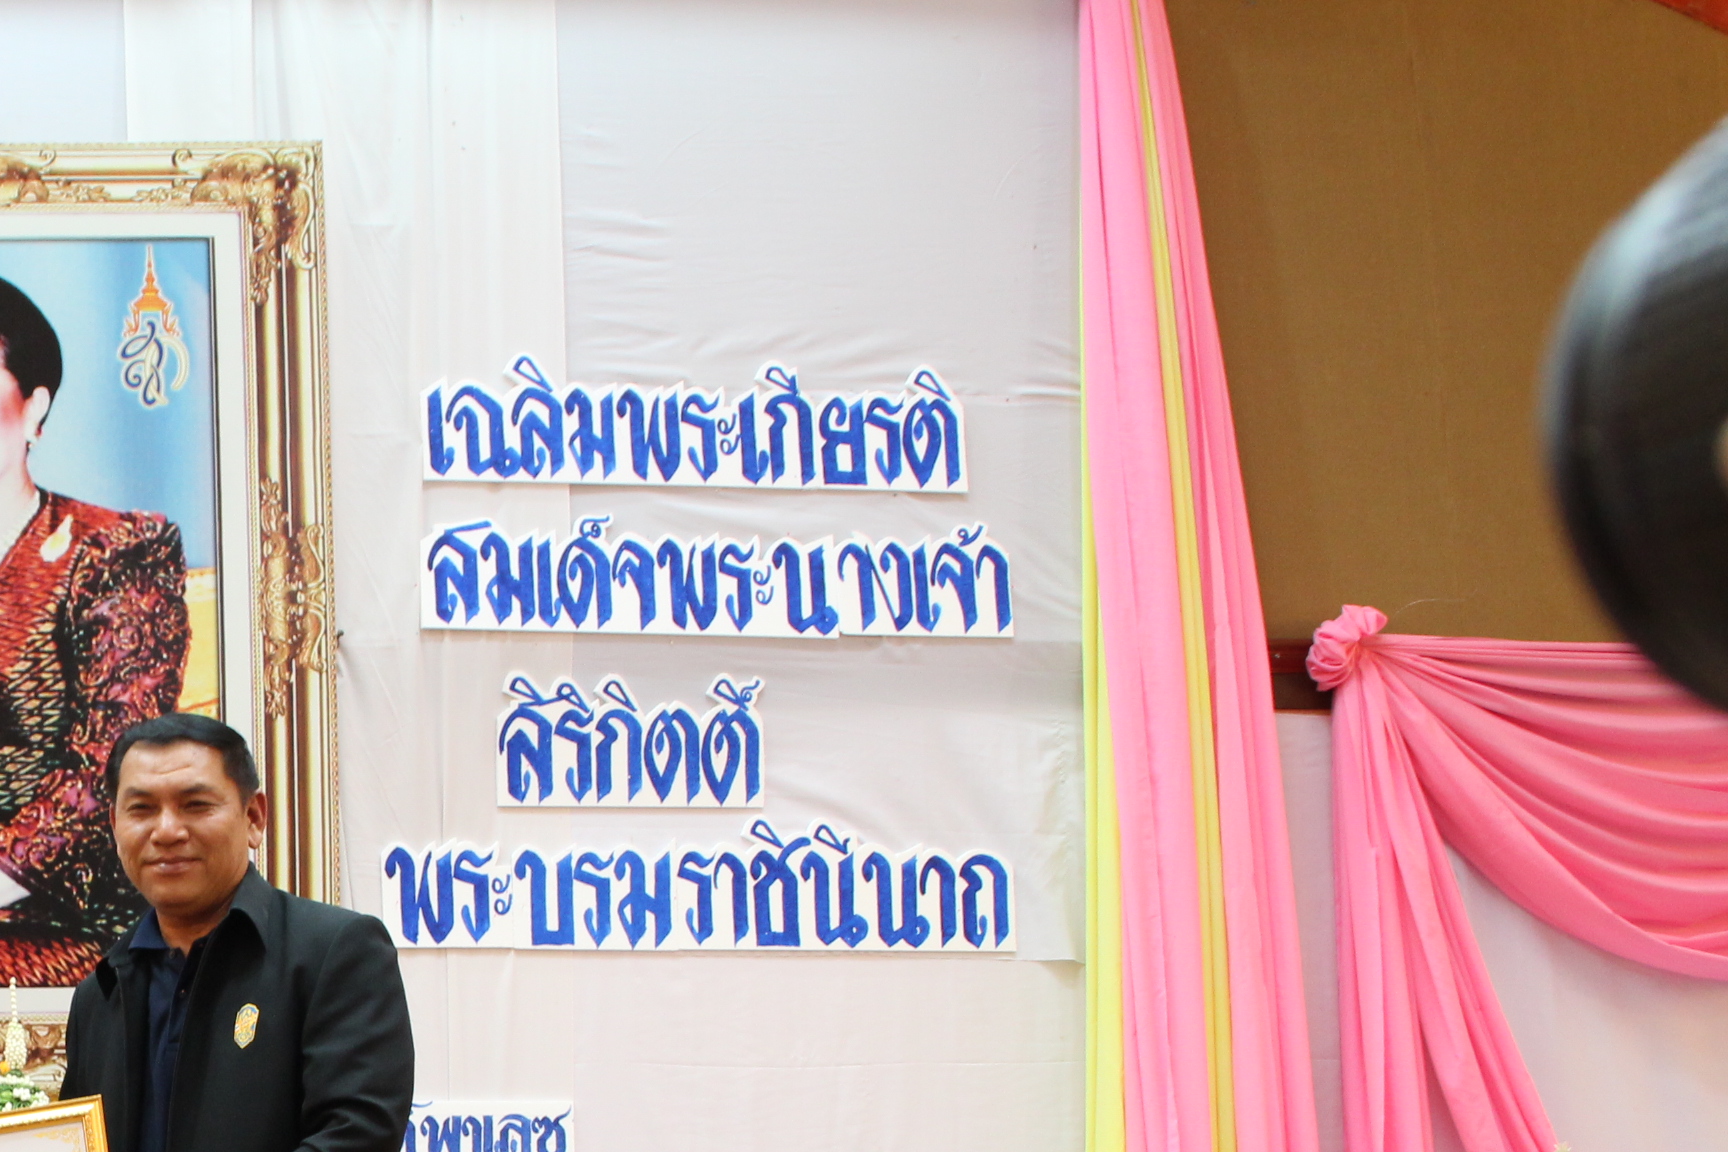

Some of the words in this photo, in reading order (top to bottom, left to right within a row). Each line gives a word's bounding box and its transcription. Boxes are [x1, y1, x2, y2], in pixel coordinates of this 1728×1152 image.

[427, 356, 961, 488] เฉลิมพระเกียรติ
[428, 515, 1013, 635] สมเด็จพระนางเจ้า
[385, 819, 1010, 948] พระบรมราชินีนาถ
